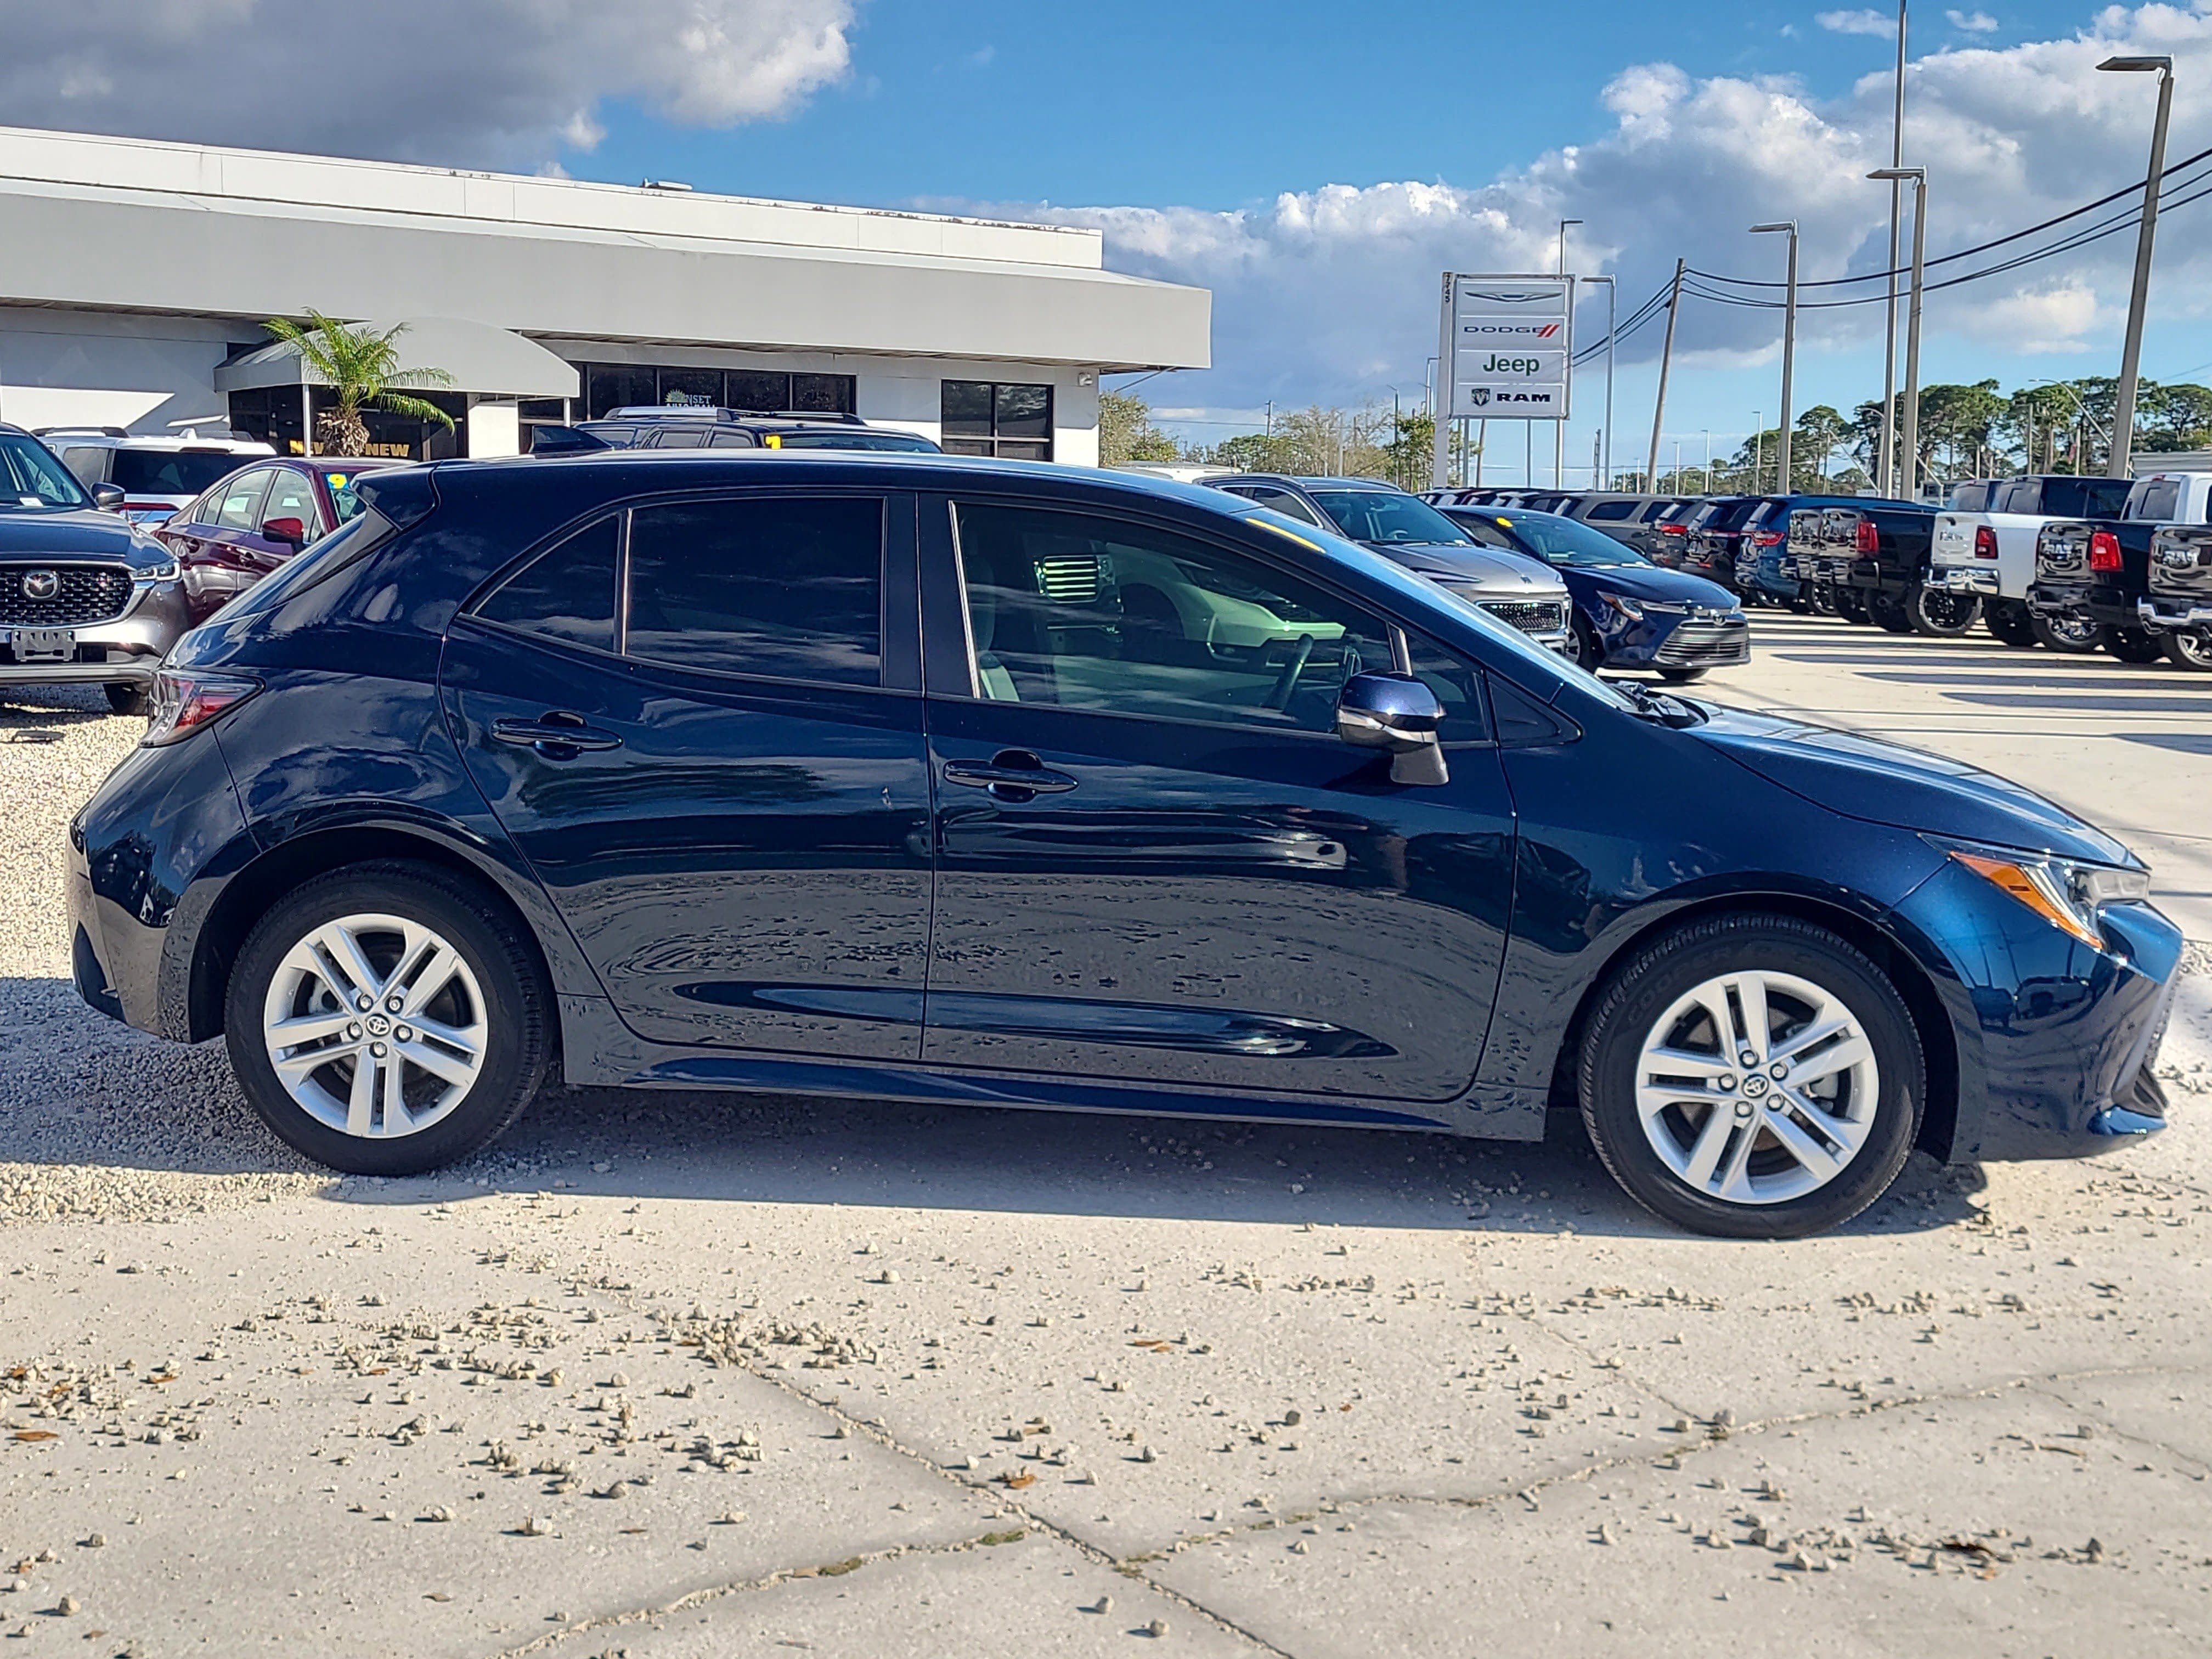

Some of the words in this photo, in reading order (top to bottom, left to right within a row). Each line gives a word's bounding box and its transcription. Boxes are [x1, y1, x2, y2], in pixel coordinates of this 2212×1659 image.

[1482, 354, 1540, 376] Jeep
[1497, 393, 1551, 402] RAM
[365, 443, 409, 456] NEW
